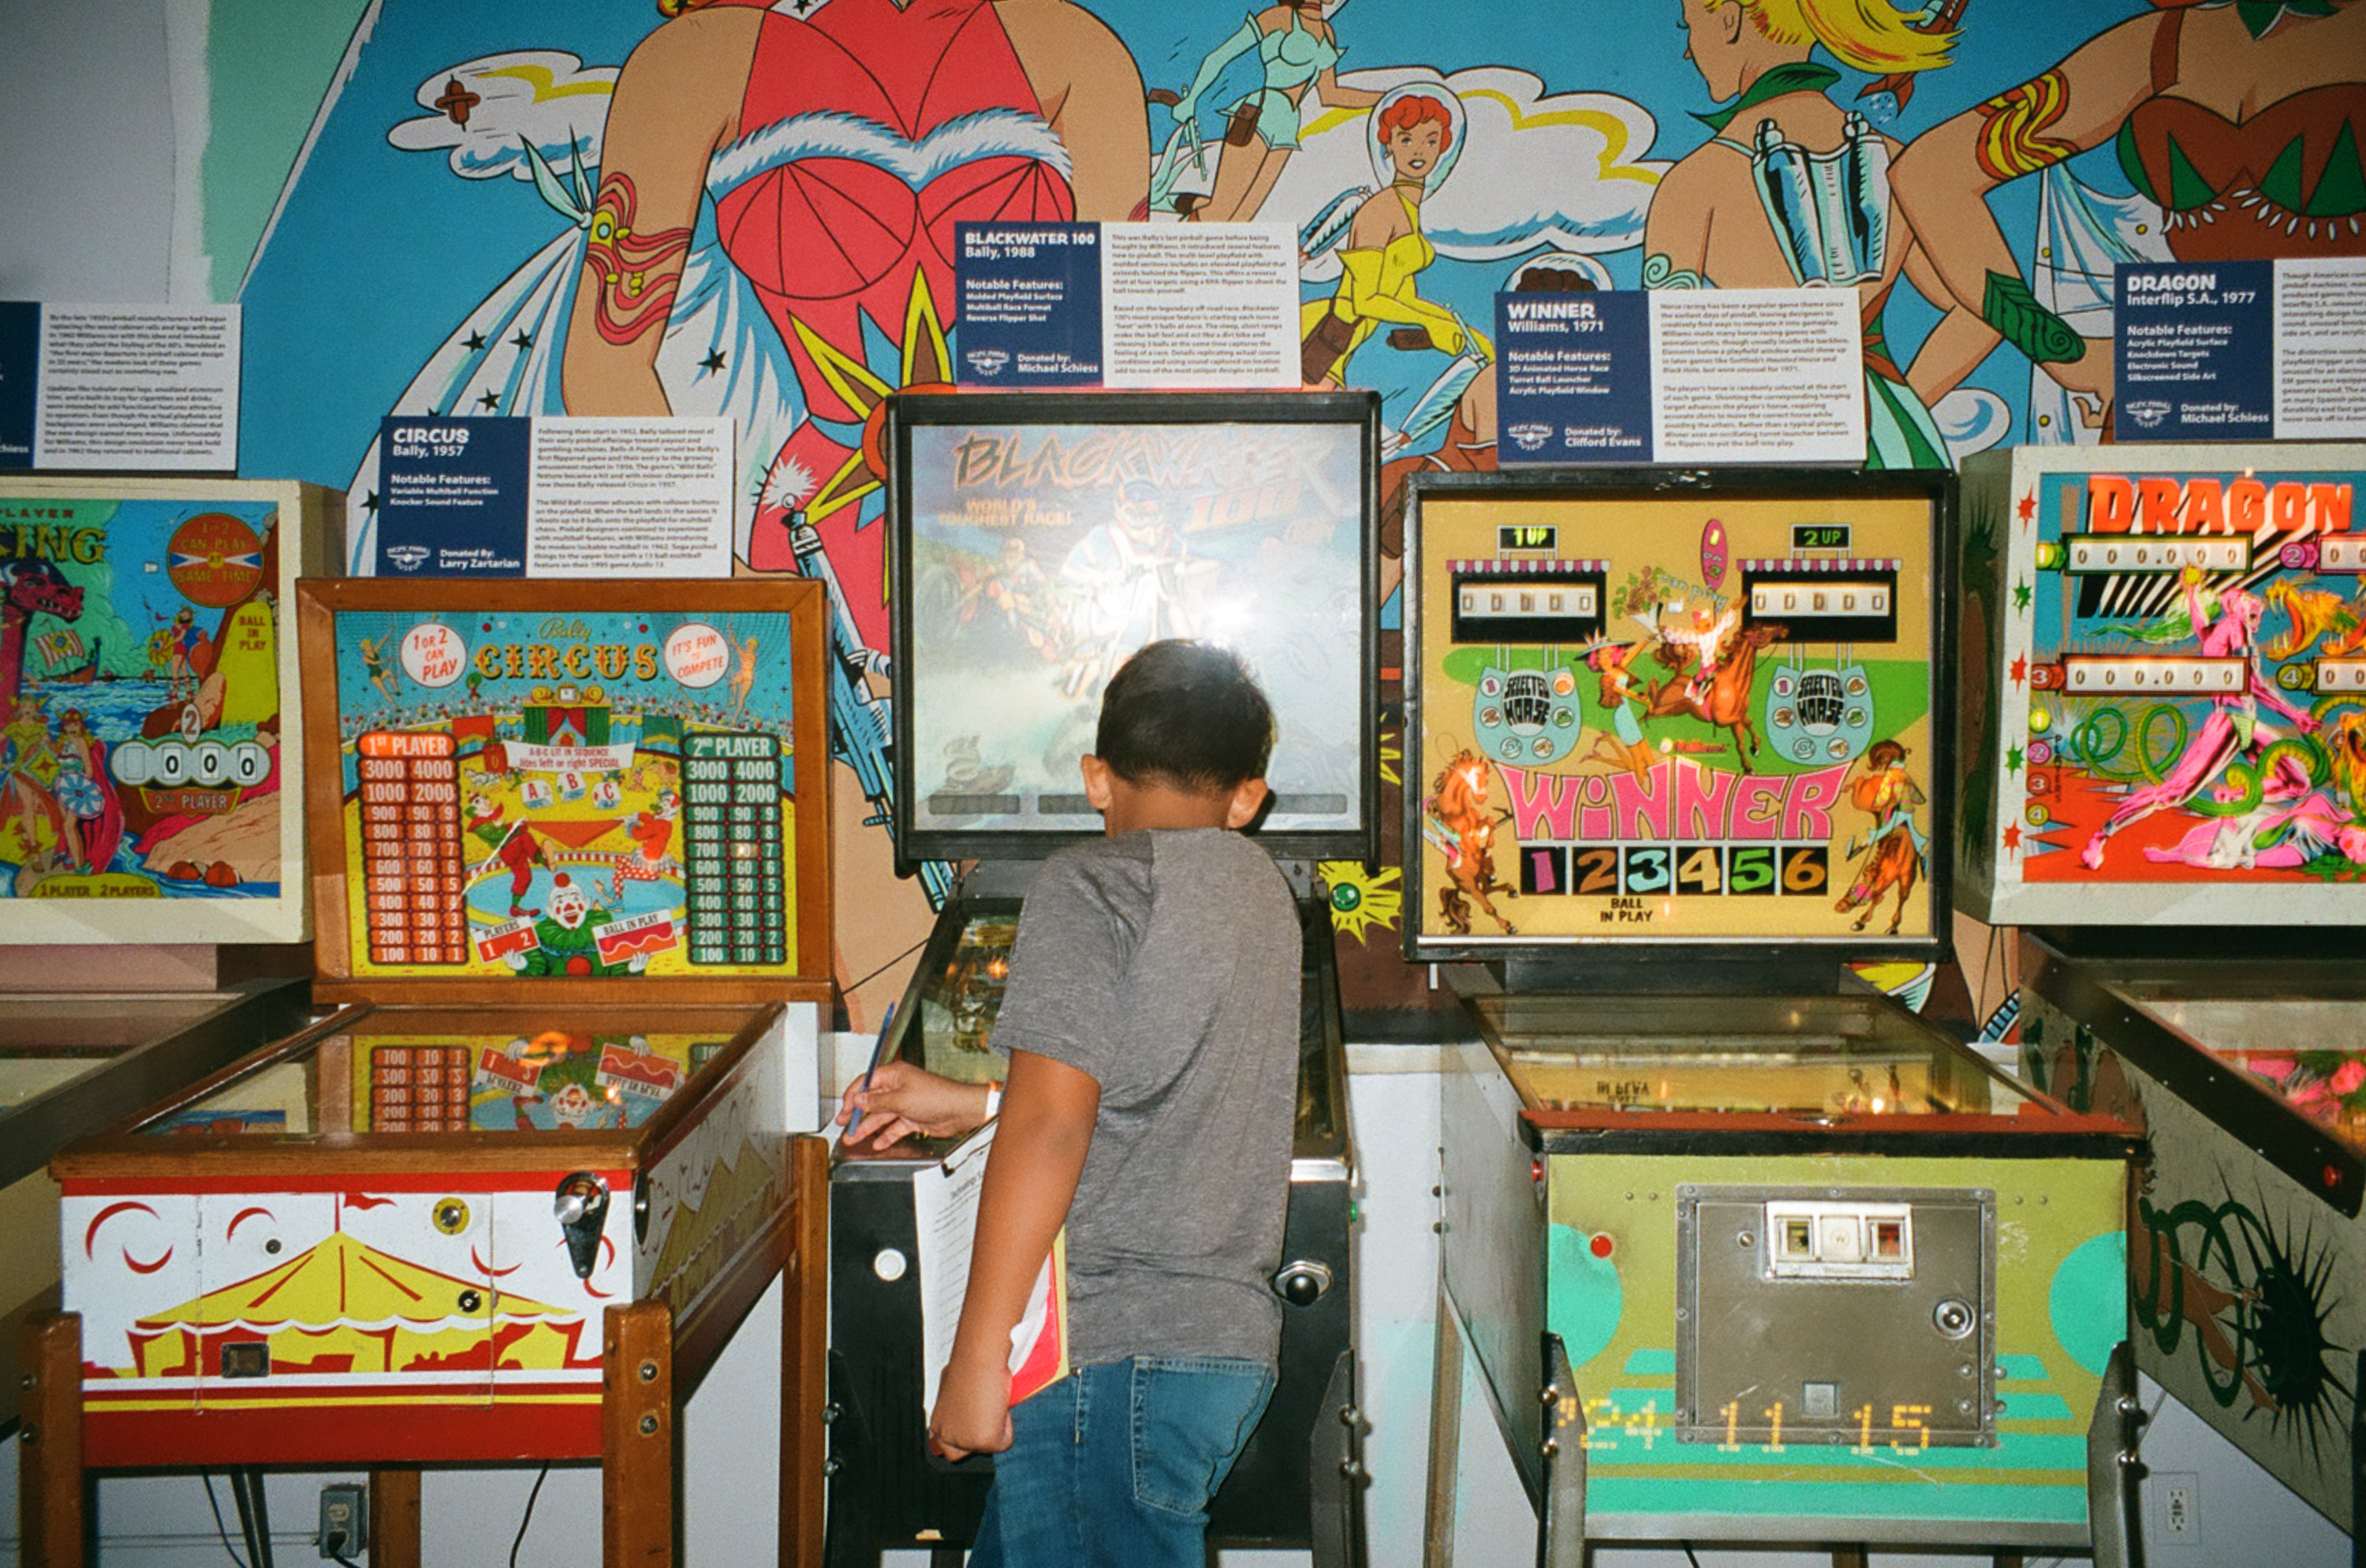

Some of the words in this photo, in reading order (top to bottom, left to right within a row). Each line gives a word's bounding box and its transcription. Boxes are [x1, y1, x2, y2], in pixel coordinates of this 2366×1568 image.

[965, 233, 1068, 245] BLACKWATER
[1072, 233, 1095, 245] 100
[965, 247, 1000, 259] Bally,
[1005, 248, 1035, 257] 1988
[966, 280, 1010, 290] Notable
[1013, 280, 1063, 290] Features:
[2128, 274, 2216, 291] DRAGON
[2128, 293, 2184, 307] Interflip
[2186, 293, 2218, 304] S.A.,
[2222, 292, 2256, 304] 1977
[999, 315, 1026, 323] Flipper
[1508, 304, 1595, 319] WINNER
[1508, 320, 1569, 333] Williams,
[1574, 320, 1604, 331] 1971
[2128, 325, 2174, 335] Notable
[2177, 325, 2232, 334] Features:
[2127, 339, 2155, 348] Acrylic
[2158, 339, 2194, 348] Playfield
[1057, 354, 1071, 364] by:
[1509, 352, 1555, 361] Notable
[1557, 352, 1610, 361] Features:
[1539, 386, 1574, 395] Playfield
[2224, 403, 2238, 413] by:
[2181, 414, 2226, 423] Michael
[393, 428, 470, 443] CIRCUS
[1607, 427, 1621, 438] by:
[1565, 438, 1606, 446] Clifford
[393, 445, 429, 458] Bally,
[433, 446, 465, 456] 1957
[391, 475, 436, 484] Notable
[438, 475, 491, 484] Features:
[953, 431, 1342, 514] BLACKWATER
[966, 498, 1036, 513] WORLD'S
[1186, 478, 1304, 534] 100
[2088, 474, 2352, 533] DRAGON
[939, 513, 1017, 526] TOUGHEST
[1024, 512, 1071, 526] RACE!
[181, 539, 207, 550] CAN
[215, 539, 246, 550] PLAY
[1514, 528, 1523, 546] 1
[1527, 528, 1547, 546] UP
[1804, 530, 1818, 546] 2
[1822, 529, 1841, 544] UP
[481, 550, 494, 558] By:
[2287, 548, 2302, 563] 2
[440, 559, 468, 569] Larry
[470, 559, 520, 568] Zartarian
[177, 570, 213, 583] SAME
[222, 570, 252, 583] TIME
[240, 615, 266, 626] BALL
[248, 628, 259, 638] IN
[538, 618, 592, 642] Bally
[240, 640, 267, 651] PLAY
[413, 634, 420, 650] 1
[422, 636, 435, 648] OR
[438, 628, 448, 644] 2
[673, 640, 691, 656] IT'S
[696, 634, 716, 648] FUN
[426, 648, 445, 662] CAN
[475, 644, 658, 680] CIRCUS
[423, 658, 457, 681] PLAY
[677, 656, 724, 678] COMPETE
[2282, 668, 2299, 685] 4
[1505, 675, 1549, 699] SELECTED
[1797, 675, 1844, 699] SELECTED
[1504, 697, 1551, 726] HORSE
[1797, 697, 1844, 726] HORSE
[369, 737, 386, 756] 1ST
[393, 737, 448, 756] PLAYER
[565, 748, 572, 756] IN
[574, 748, 609, 757] SEQUENCE
[692, 737, 713, 757] 2ND
[716, 737, 770, 757] PLAYER
[366, 760, 405, 778] 3000
[414, 760, 453, 778] 4000
[588, 759, 620, 768] SPECIAL
[689, 761, 727, 779] 3000
[737, 762, 774, 779] 4000
[368, 784, 405, 802] 1000
[415, 784, 454, 801] 2000
[691, 784, 727, 803] 1000
[737, 784, 776, 803] 2000
[181, 794, 227, 809] PLAYER
[1531, 851, 1555, 893] 1
[1577, 850, 1617, 893] 2
[1626, 849, 1670, 893] 3
[1679, 848, 1721, 893] 4
[1730, 849, 1774, 893] 5
[1783, 849, 1826, 893] 6
[50, 885, 90, 896] PLAYER
[100, 884, 108, 897] 2
[110, 885, 155, 896] PLAYERS
[1610, 898, 1644, 909] BALL
[603, 920, 625, 935] BALL
[625, 918, 637, 931] IN
[637, 913, 659, 928] PLAY
[1599, 912, 1614, 923] IN
[1619, 911, 1653, 923] PLAY
[483, 920, 521, 939] PLAYERS
